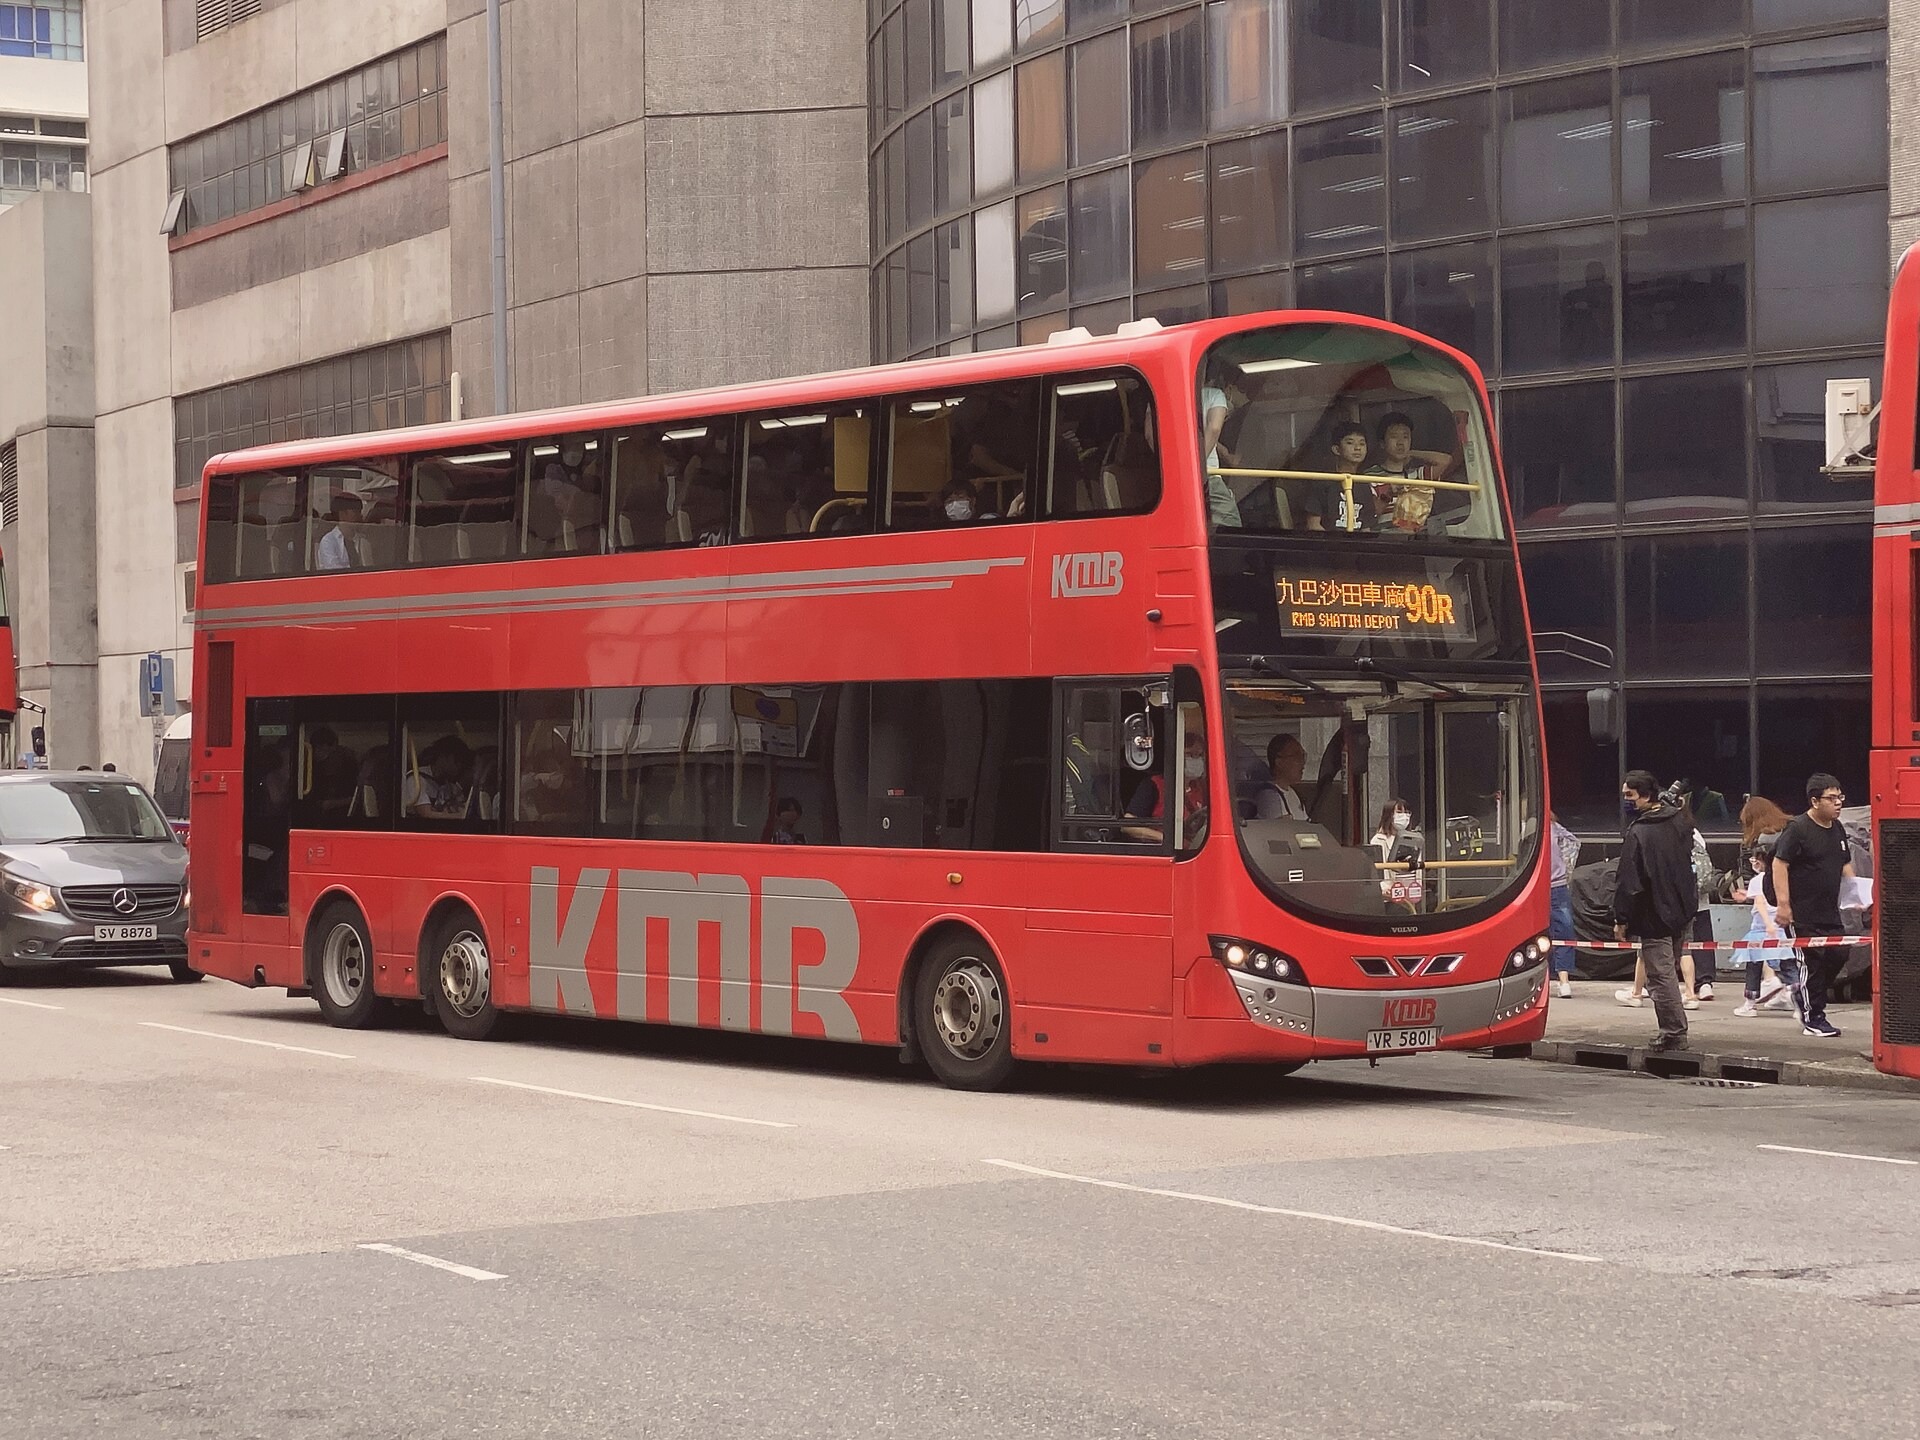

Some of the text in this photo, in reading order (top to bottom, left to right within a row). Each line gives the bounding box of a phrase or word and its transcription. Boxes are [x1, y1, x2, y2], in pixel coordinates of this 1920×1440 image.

[1051, 551, 1124, 599] KMB
[1276, 577, 1406, 608] 九巴沙田車廠
[1404, 584, 1456, 625] 90R
[1318, 612, 1362, 628] SHATIN
[1364, 614, 1400, 629] DEPOT
[150, 657, 160, 689] P
[99, 927, 152, 939] SV 8878
[1382, 998, 1437, 1028] KMB
[1373, 1032, 1392, 1049] VR
